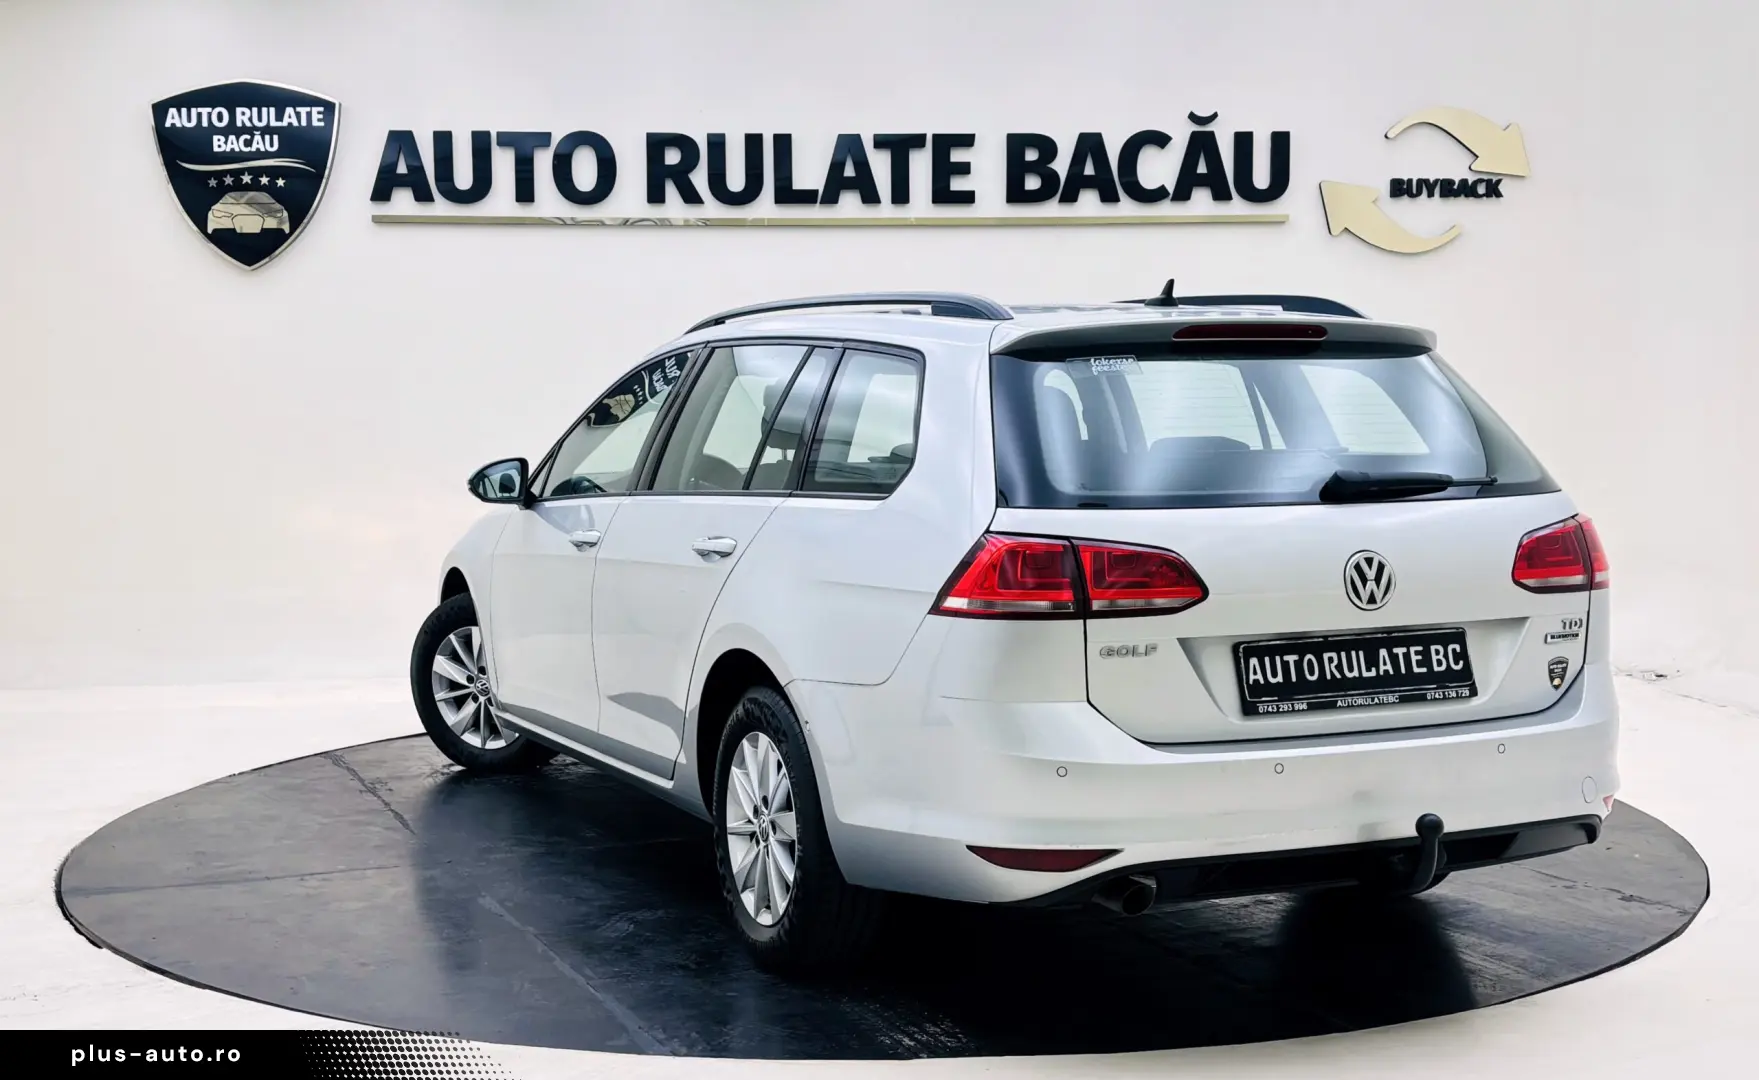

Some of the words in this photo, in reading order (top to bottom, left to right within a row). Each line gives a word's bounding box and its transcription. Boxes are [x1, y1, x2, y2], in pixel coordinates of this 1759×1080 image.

[165, 107, 229, 128] AUTO
[236, 106, 325, 127] RULATE
[212, 131, 279, 152] BACĂU
[370, 129, 617, 205] AUTO
[646, 131, 976, 206] RULATE
[1006, 110, 1291, 205] BACĂU
[1389, 178, 1504, 198] BUYBACK
[1099, 643, 1158, 659] GOLF
[1248, 654, 1320, 685] AUTO
[1322, 646, 1427, 680] RULATE
[1430, 643, 1464, 672] BC
[1336, 695, 1400, 707] AUTORULATEBC
[1426, 691, 1444, 700] 0743
[1259, 704, 1277, 713] 0743
